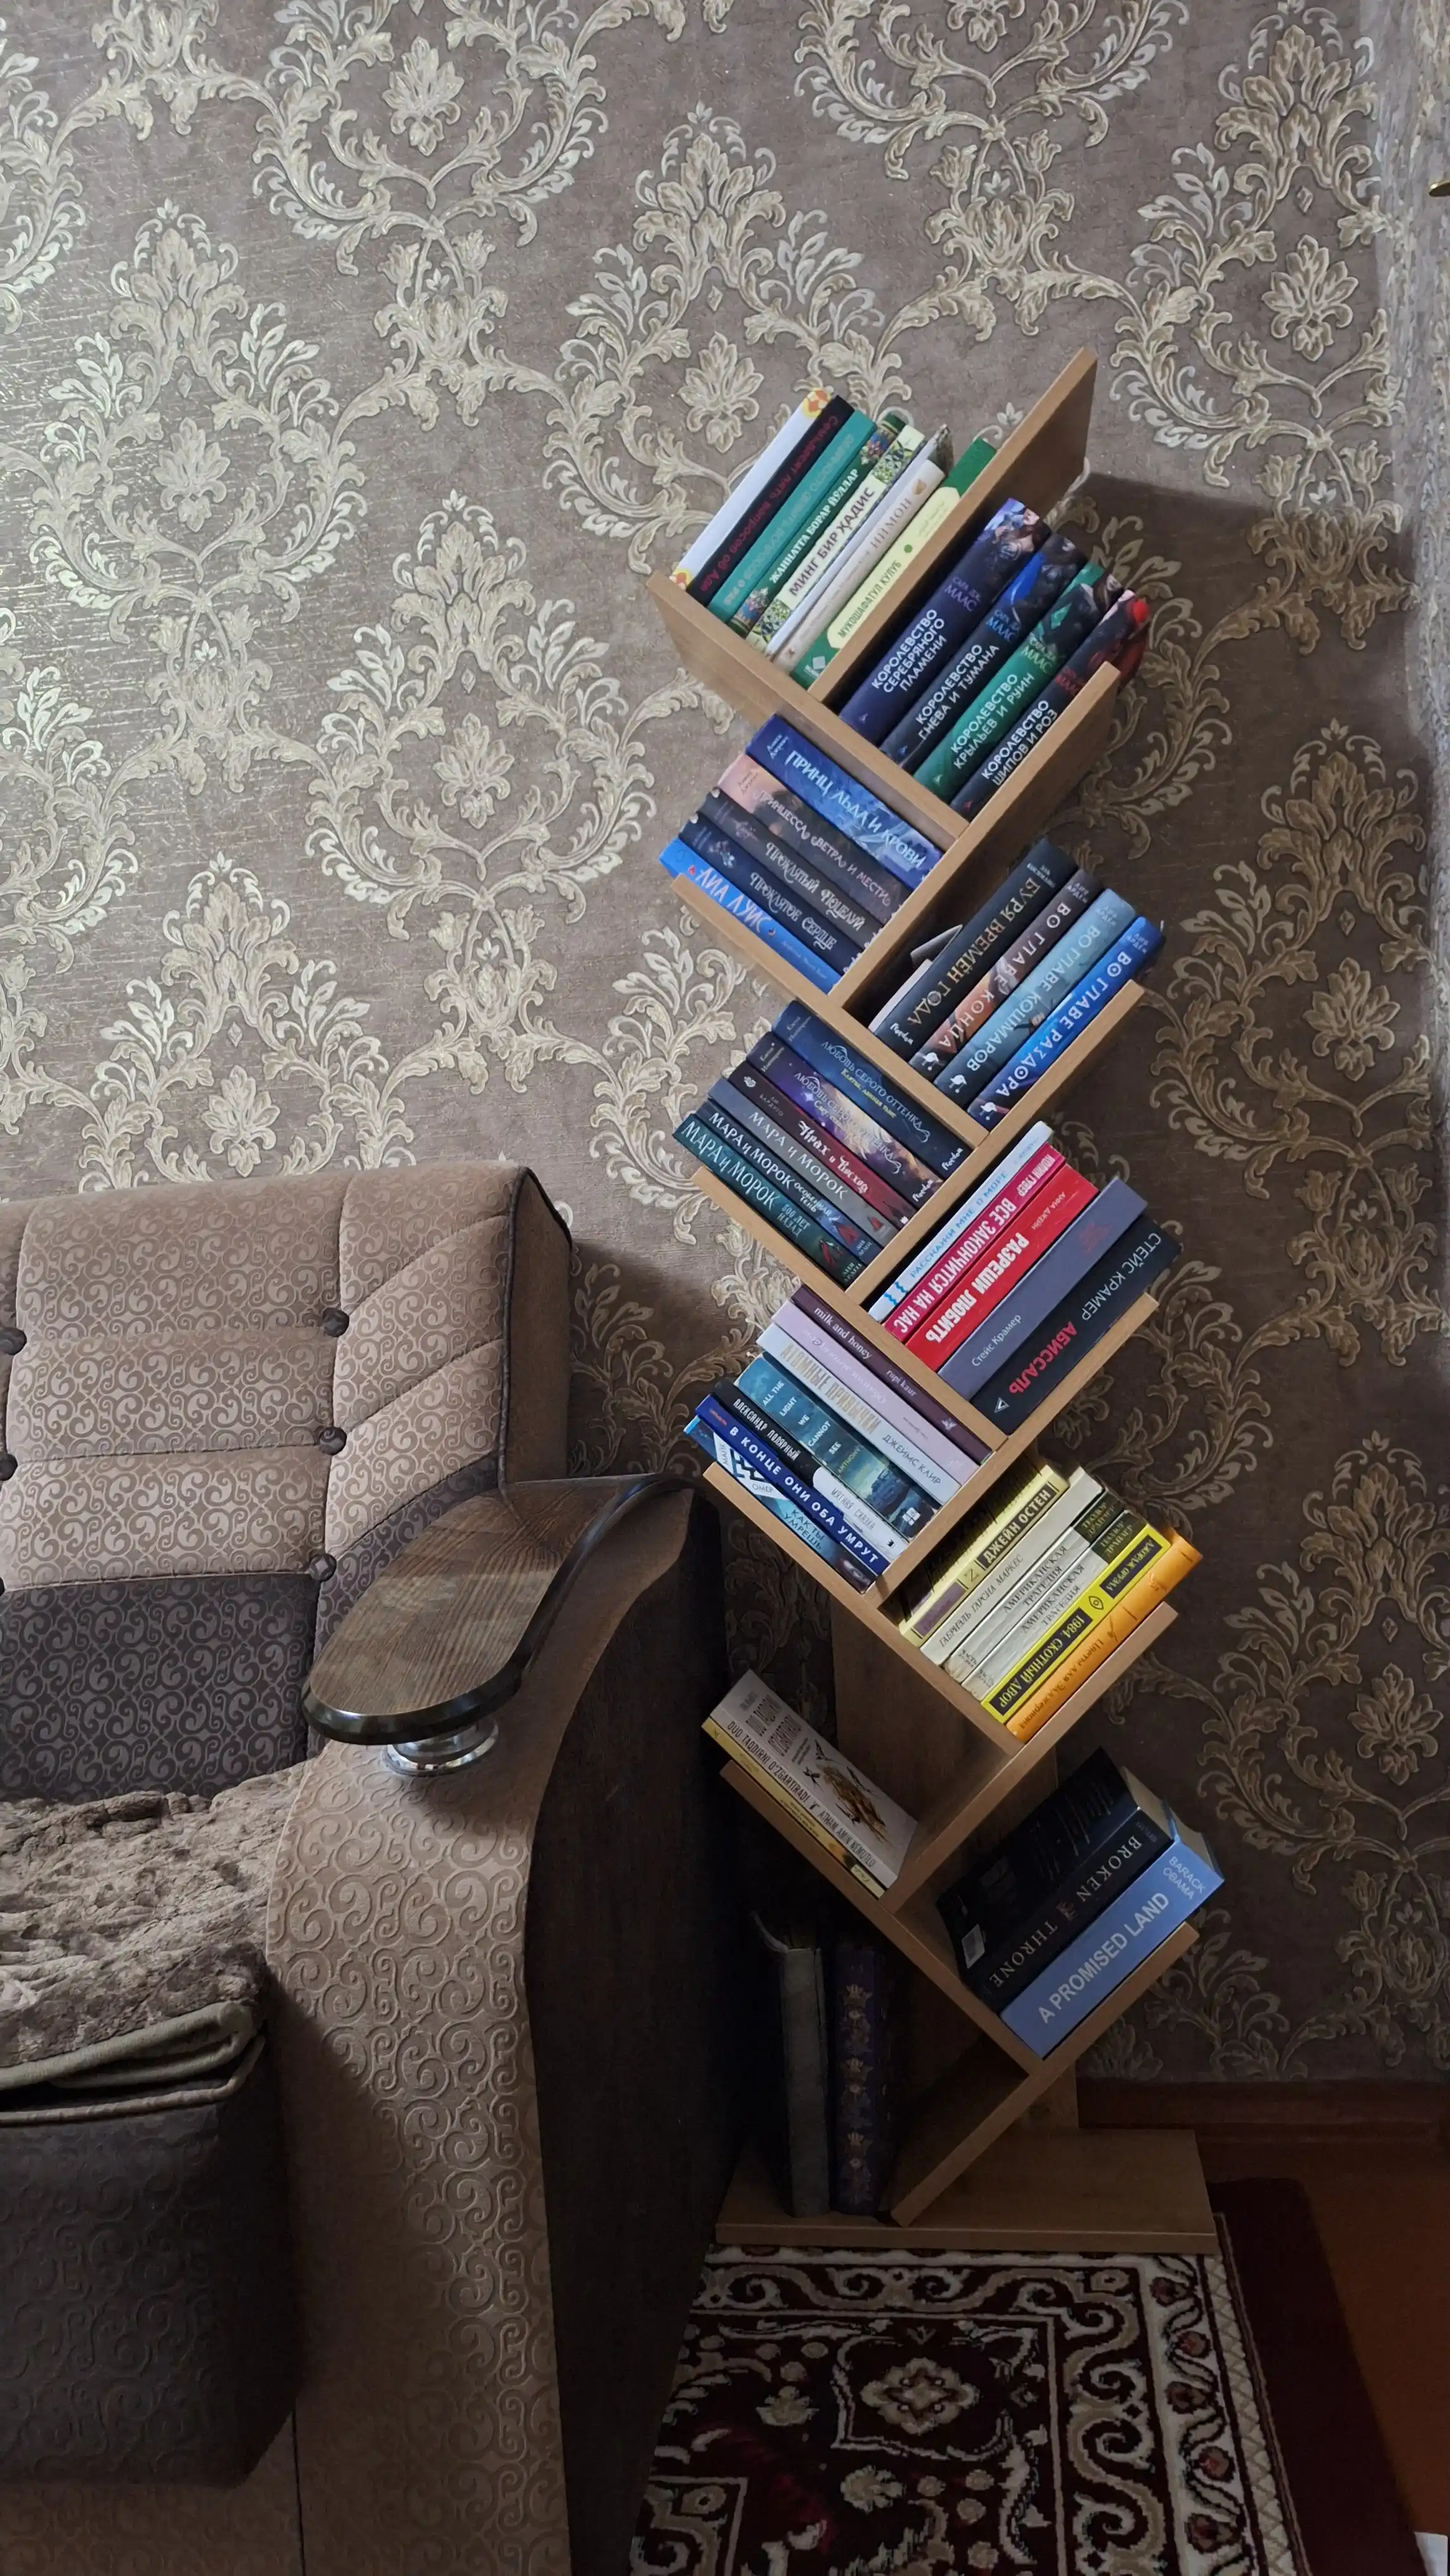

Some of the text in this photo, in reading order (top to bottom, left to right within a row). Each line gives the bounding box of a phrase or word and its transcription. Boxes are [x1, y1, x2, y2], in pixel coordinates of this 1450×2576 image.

[805, 503, 834, 536] БОРАР
[716, 552, 733, 571] об
[787, 558, 820, 597] МИНГ
[815, 530, 842, 561] БИР
[836, 581, 884, 640] МУКОШАФАТУЛ
[944, 582, 977, 612] МААС
[869, 607, 939, 690] КОРОЛЕВСТВО
[881, 616, 947, 695] СЕРЕБРЯНОГО
[985, 615, 1016, 643] МААС
[897, 633, 948, 692] ПЛАМЕНИ
[914, 641, 984, 726] КОРОЛЕВСТВО
[1020, 644, 1053, 674] МААС
[917, 701, 953, 742] ГНЕВА
[947, 690, 961, 704] И
[957, 641, 1001, 691] ТУМАНА
[949, 672, 1020, 754] КОРОЛЕВСТВО
[951, 671, 1036, 770] КРЫЛЬЕВ И РУИН
[980, 698, 1052, 781] КОРОЛЕВСТВО
[990, 707, 1059, 787] ШИПОВ И РОЗ
[782, 749, 835, 796] ПРИНЦ
[829, 786, 873, 827] ЛЬДА
[866, 816, 884, 833] И
[878, 826, 926, 869] КРОВИ
[749, 785, 814, 840] ПРИНЦЕССА
[808, 833, 850, 869] ВЕТРА
[846, 862, 858, 874] И
[852, 870, 896, 908] МЕСТИ
[693, 864, 772, 934] ЛИА ЛУИС
[905, 876, 1041, 1030] БУРЯ ВРЕМЁН ГОДА
[936, 900, 1072, 1051] ВО ГЛАВЕ КОНЦА
[1103, 950, 1133, 981] ВО
[963, 923, 1102, 1073] ВО ГЛАВЕ КОШМАРОВ
[1058, 975, 1110, 1031] ГЛАВЕ
[791, 1070, 832, 1103] ЛЮБОВЬ
[818, 1039, 858, 1072] ЛЮБОВЬ
[852, 1067, 889, 1097] СЕРОГО
[882, 1092, 927, 1130] ОТТЕНКА
[994, 1025, 1063, 1101] РАЗДОРА
[678, 1119, 782, 1211] МАРА МОРОК
[706, 1110, 798, 1191] МАРА МОРОК
[745, 1109, 789, 1149] МАРА
[793, 1152, 851, 1200] МОРОК
[791, 1119, 834, 1156] Прах
[827, 1154, 837, 1164] и
[830, 1155, 875, 1195] Восход
[774, 1212, 804, 1238] НАЗАД
[779, 1203, 811, 1231] 500 ЛЕТ
[908, 1170, 1009, 1279] РАССКАЖИ МНЕ О МОРЕ
[1029, 1190, 1068, 1231] АННА ДЖЕЙН
[890, 1195, 1018, 1335] ВСЕ ЗАКОНЧИТСЯ НА НАС
[966, 1231, 1034, 1296] РАЗРЕШИ
[1118, 1230, 1166, 1277] СТЕЙС
[920, 1288, 981, 1347] ЛЮБИТЬ
[1074, 1269, 1128, 1322] КРАМЕР
[813, 1305, 836, 1327] milk
[831, 1321, 851, 1340] and
[845, 1335, 874, 1362] honey
[969, 1312, 1025, 1368] Стейс Крамер
[1003, 1320, 1082, 1398] АБИССАЛЬ
[760, 1379, 785, 1406] ALL THE
[778, 1340, 832, 1392] АТОМНЫЕ
[823, 1380, 883, 1436] ПРИВЫЧКИ
[778, 1395, 798, 1417] LIGHT
[884, 1368, 918, 1398] rupi kaur
[731, 1397, 769, 1433] АЛЕКСАНДР
[765, 1427, 802, 1462] ПОЛЯРНЫЙ
[797, 1413, 810, 1427] WE
[806, 1419, 832, 1448] CANNOT
[827, 1440, 842, 1455] SEE
[720, 1443, 731, 1465] МАЙК
[836, 1443, 863, 1474] ANTHONY
[880, 1431, 943, 1488] ДЖЕЙМС КЛИР
[728, 1426, 740, 1438] В
[738, 1436, 782, 1477] КОНЦЕ
[782, 1474, 812, 1502] ОНИ
[809, 1500, 837, 1527] ОБА
[836, 1525, 879, 1565] УМРУТ
[752, 1483, 774, 1493] ОМЕР
[829, 1486, 877, 1531] МЯТНАЯ СКАЗКА
[781, 1512, 825, 1551] УМРЕШЬ
[789, 1508, 825, 1541] КАК ТЫ
[980, 1488, 1053, 1565] ДЖЕЙН ОСТЕН
[1001, 1543, 1069, 1614] АМЕРИКАНСКАЯ
[1125, 1539, 1156, 1571] ДЖОРДЖ
[938, 1610, 973, 1647] ГАБРИЭЛЬ
[969, 1583, 997, 1613] ГАРСИА
[993, 1553, 1025, 1586] МАРКЕС
[1018, 1563, 1087, 1634] АМЕРИКАНСКАЯ
[1022, 1564, 1064, 1607] ТРАГЕДИЯ
[1040, 1583, 1082, 1627] ТРАГЕДИЯ
[995, 1613, 1086, 1708] 1984. СКОТНЫЙ ДВОР
[1015, 1637, 1106, 1731] Цветы для Элджернона
[725, 1720, 745, 1739] DUO
[740, 1734, 772, 1765] TAQDIRNI
[1160, 1863, 1197, 1902] OBAMA
[1167, 1853, 1207, 1897] BARACK
[986, 1834, 1142, 1988] BROKEN THRONE
[1034, 1889, 1172, 2024] A PROMISED LAND
